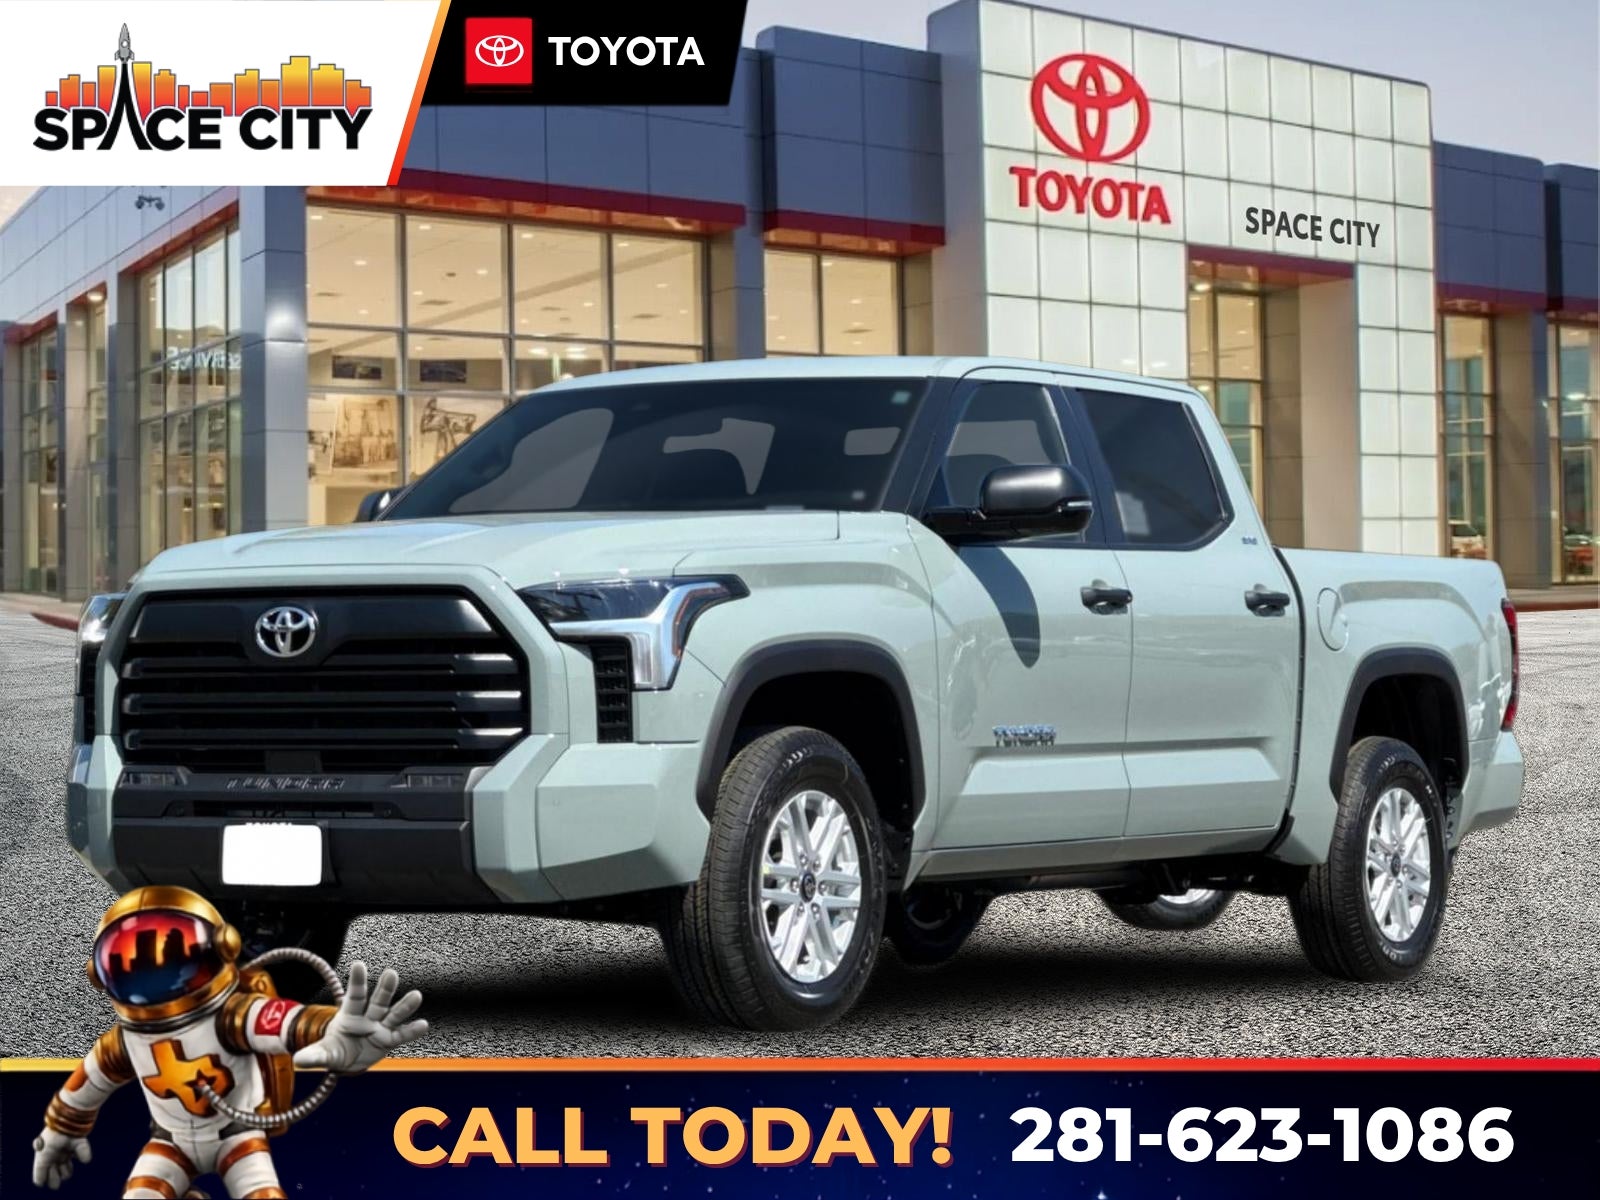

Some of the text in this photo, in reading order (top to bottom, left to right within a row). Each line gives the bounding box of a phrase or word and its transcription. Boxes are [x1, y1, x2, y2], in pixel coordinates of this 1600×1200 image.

[1009, 166, 1171, 225] TOYOTA
[1244, 206, 1380, 249] SPACE CITY
